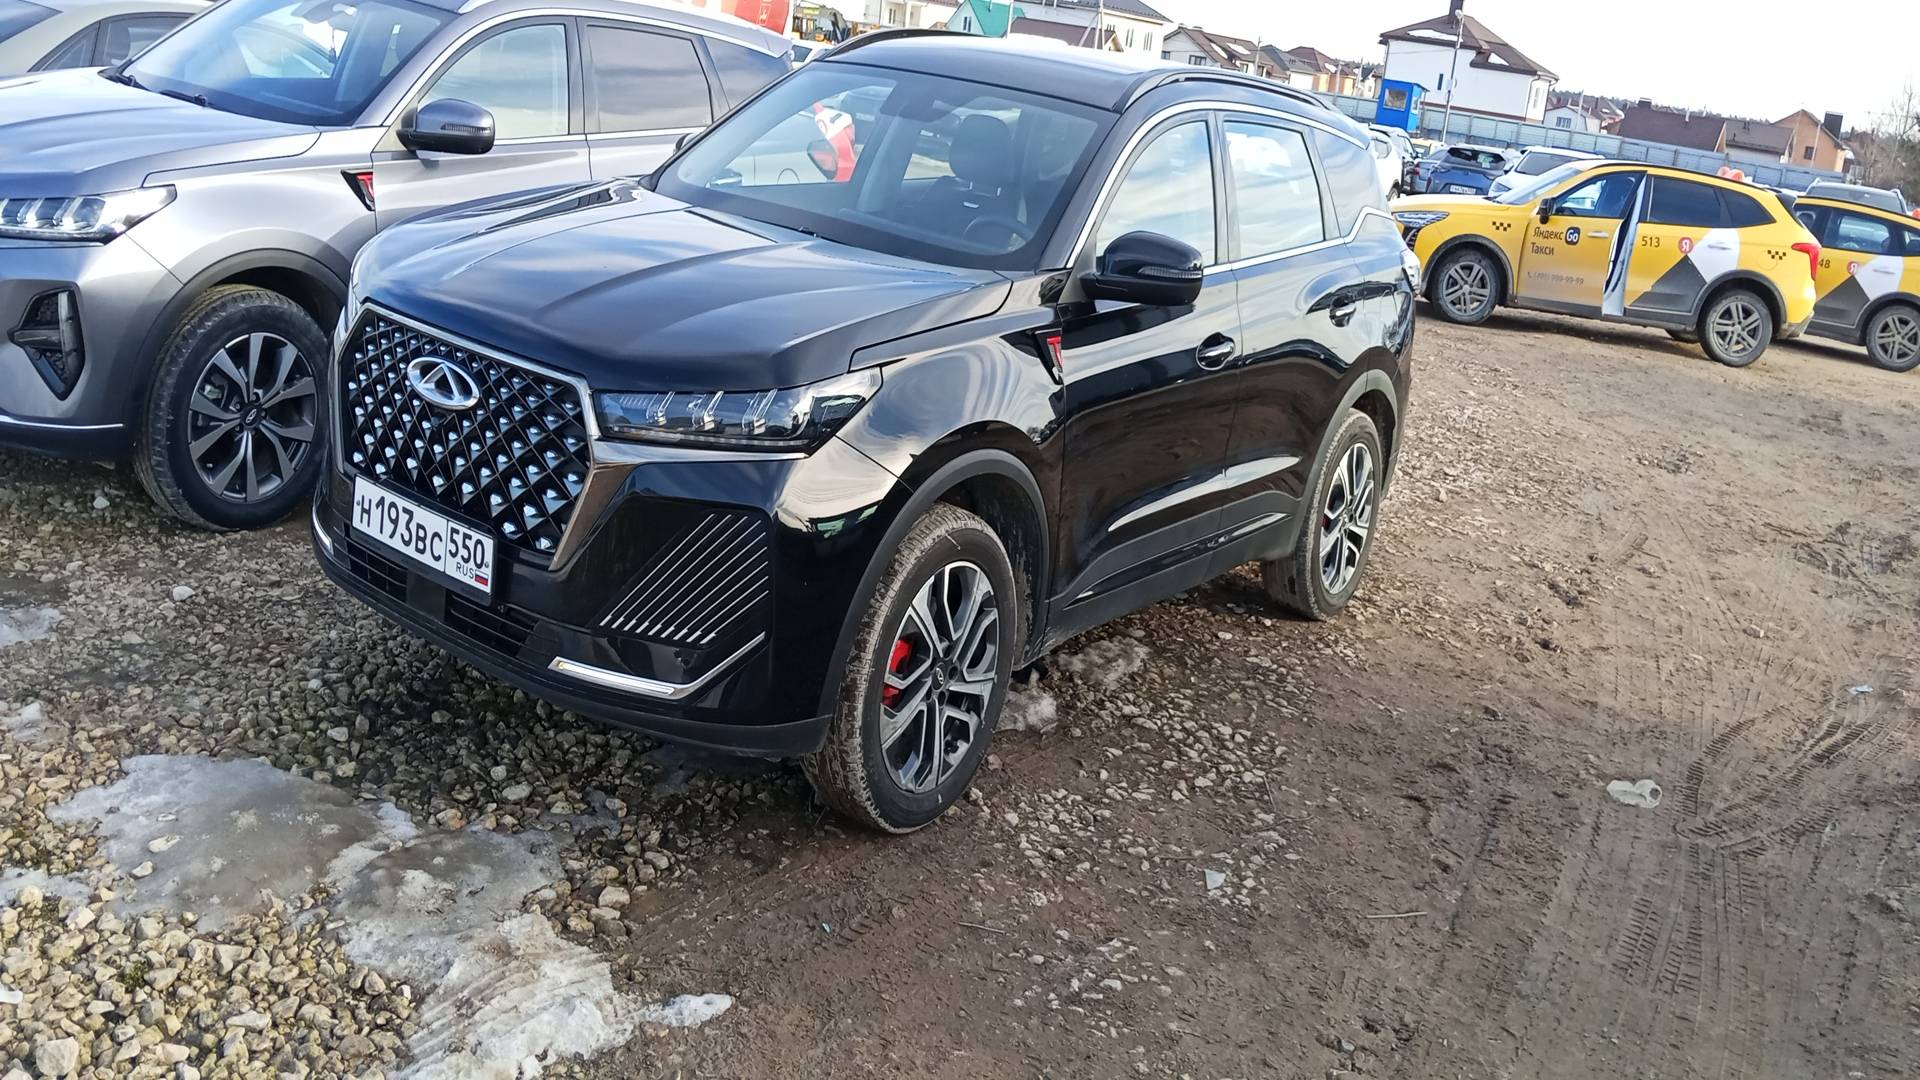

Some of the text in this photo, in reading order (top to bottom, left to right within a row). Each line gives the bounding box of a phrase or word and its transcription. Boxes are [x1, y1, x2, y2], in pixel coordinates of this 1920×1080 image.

[1532, 226, 1579, 243] Яндекс Go
[1641, 235, 1660, 248] 513
[1531, 241, 1555, 256] Такси
[448, 526, 486, 570] 550
[455, 561, 475, 580] RUS
